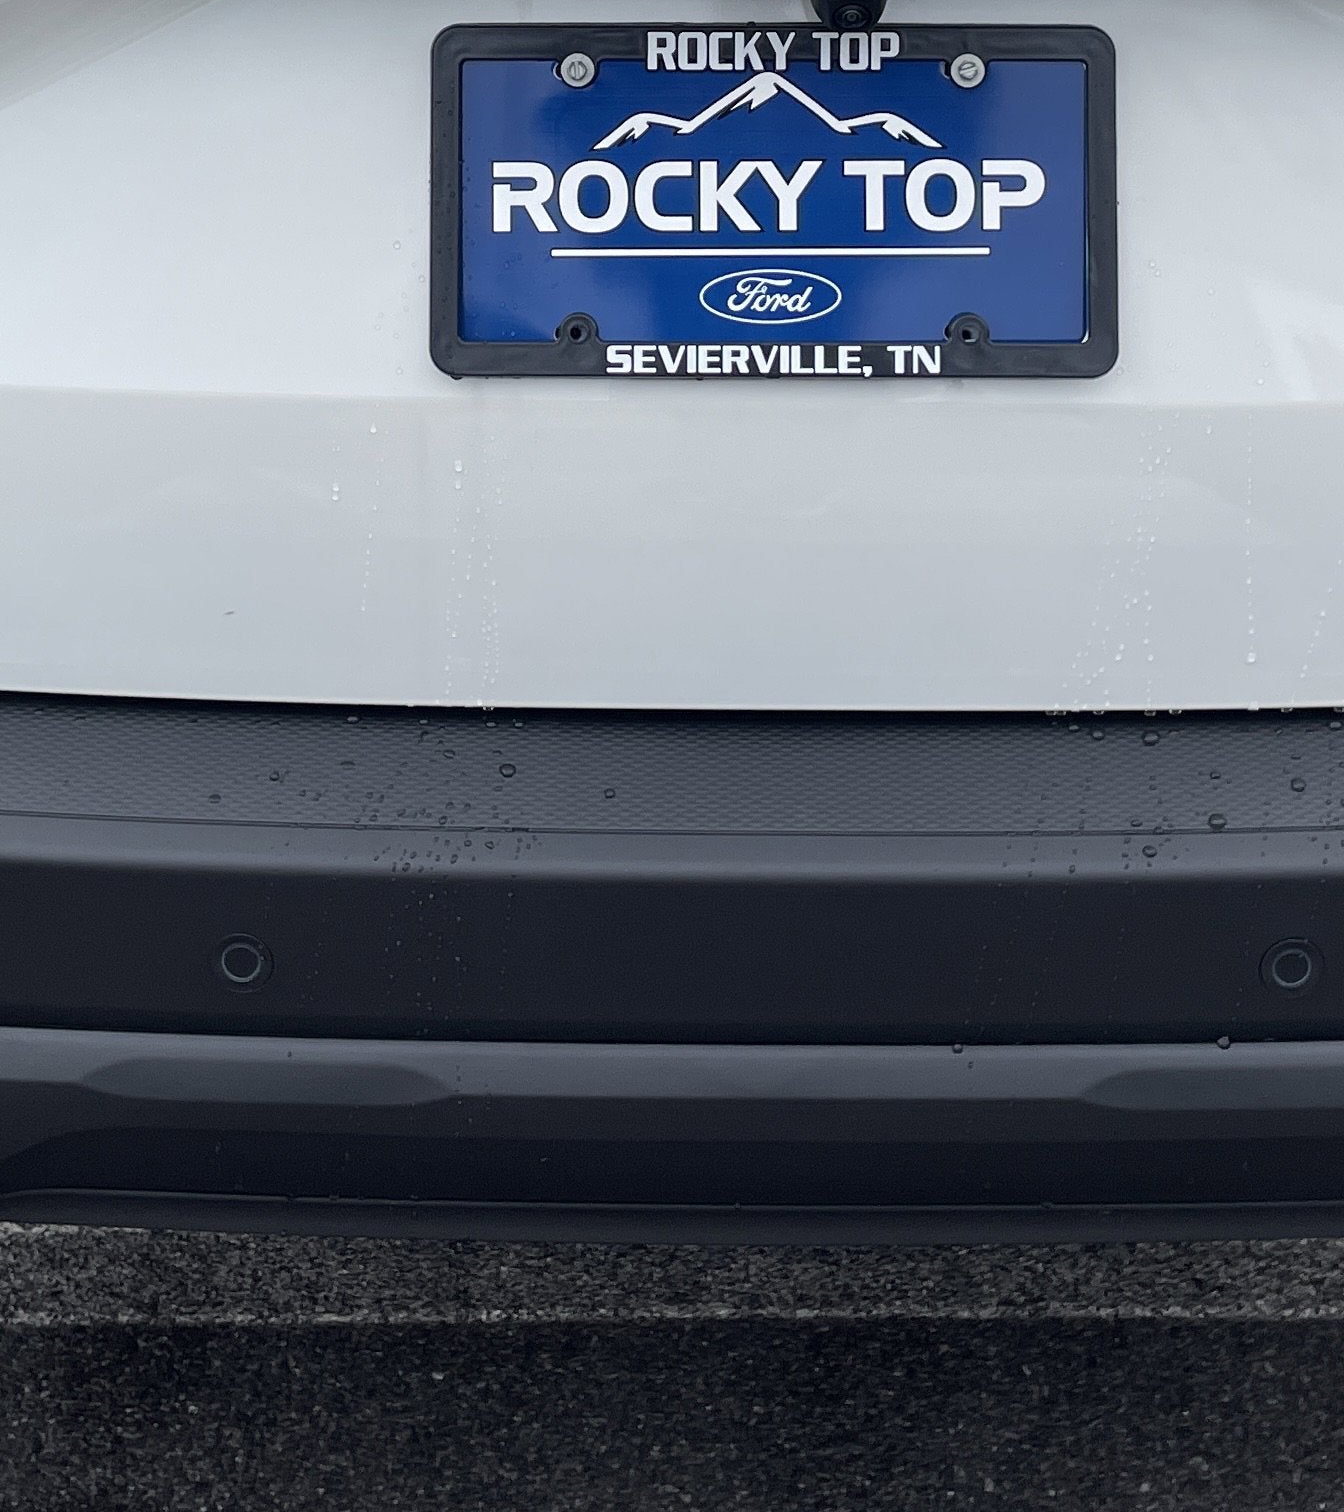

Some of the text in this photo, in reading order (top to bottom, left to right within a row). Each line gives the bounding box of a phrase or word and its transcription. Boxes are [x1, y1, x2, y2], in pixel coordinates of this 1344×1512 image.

[647, 31, 900, 72] ROCKY TOP
[491, 158, 1046, 233] ROCKY TOP
[726, 276, 812, 315] Ford
[605, 345, 941, 378] SEVIERVILLE, TN
